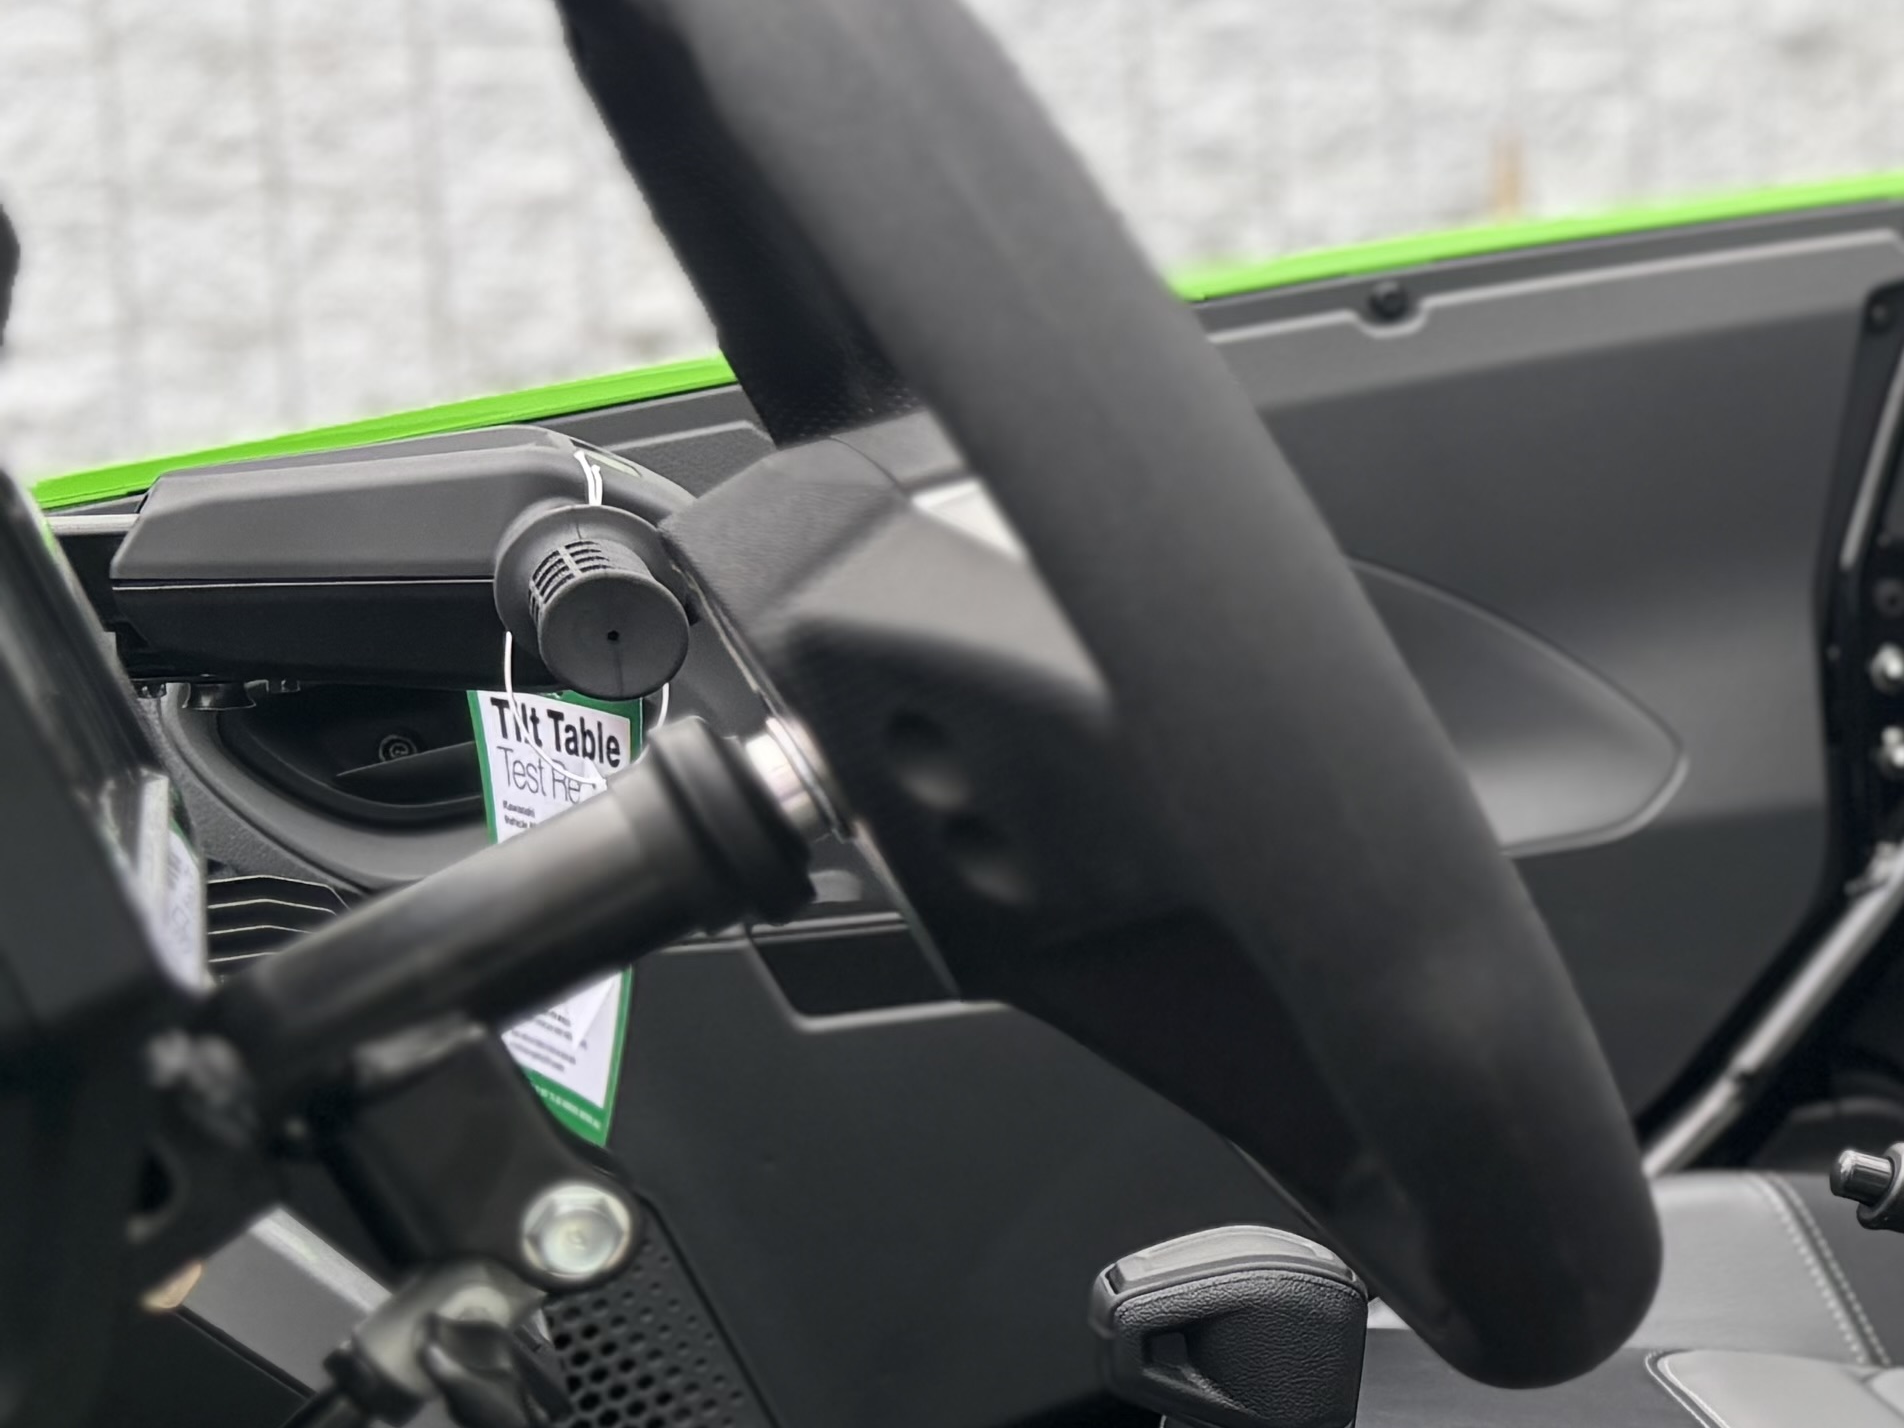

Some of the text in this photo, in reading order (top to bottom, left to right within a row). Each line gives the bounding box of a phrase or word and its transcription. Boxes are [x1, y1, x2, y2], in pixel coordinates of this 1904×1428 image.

[490, 697, 621, 768] Tilt Table
[496, 745, 547, 797] Test
